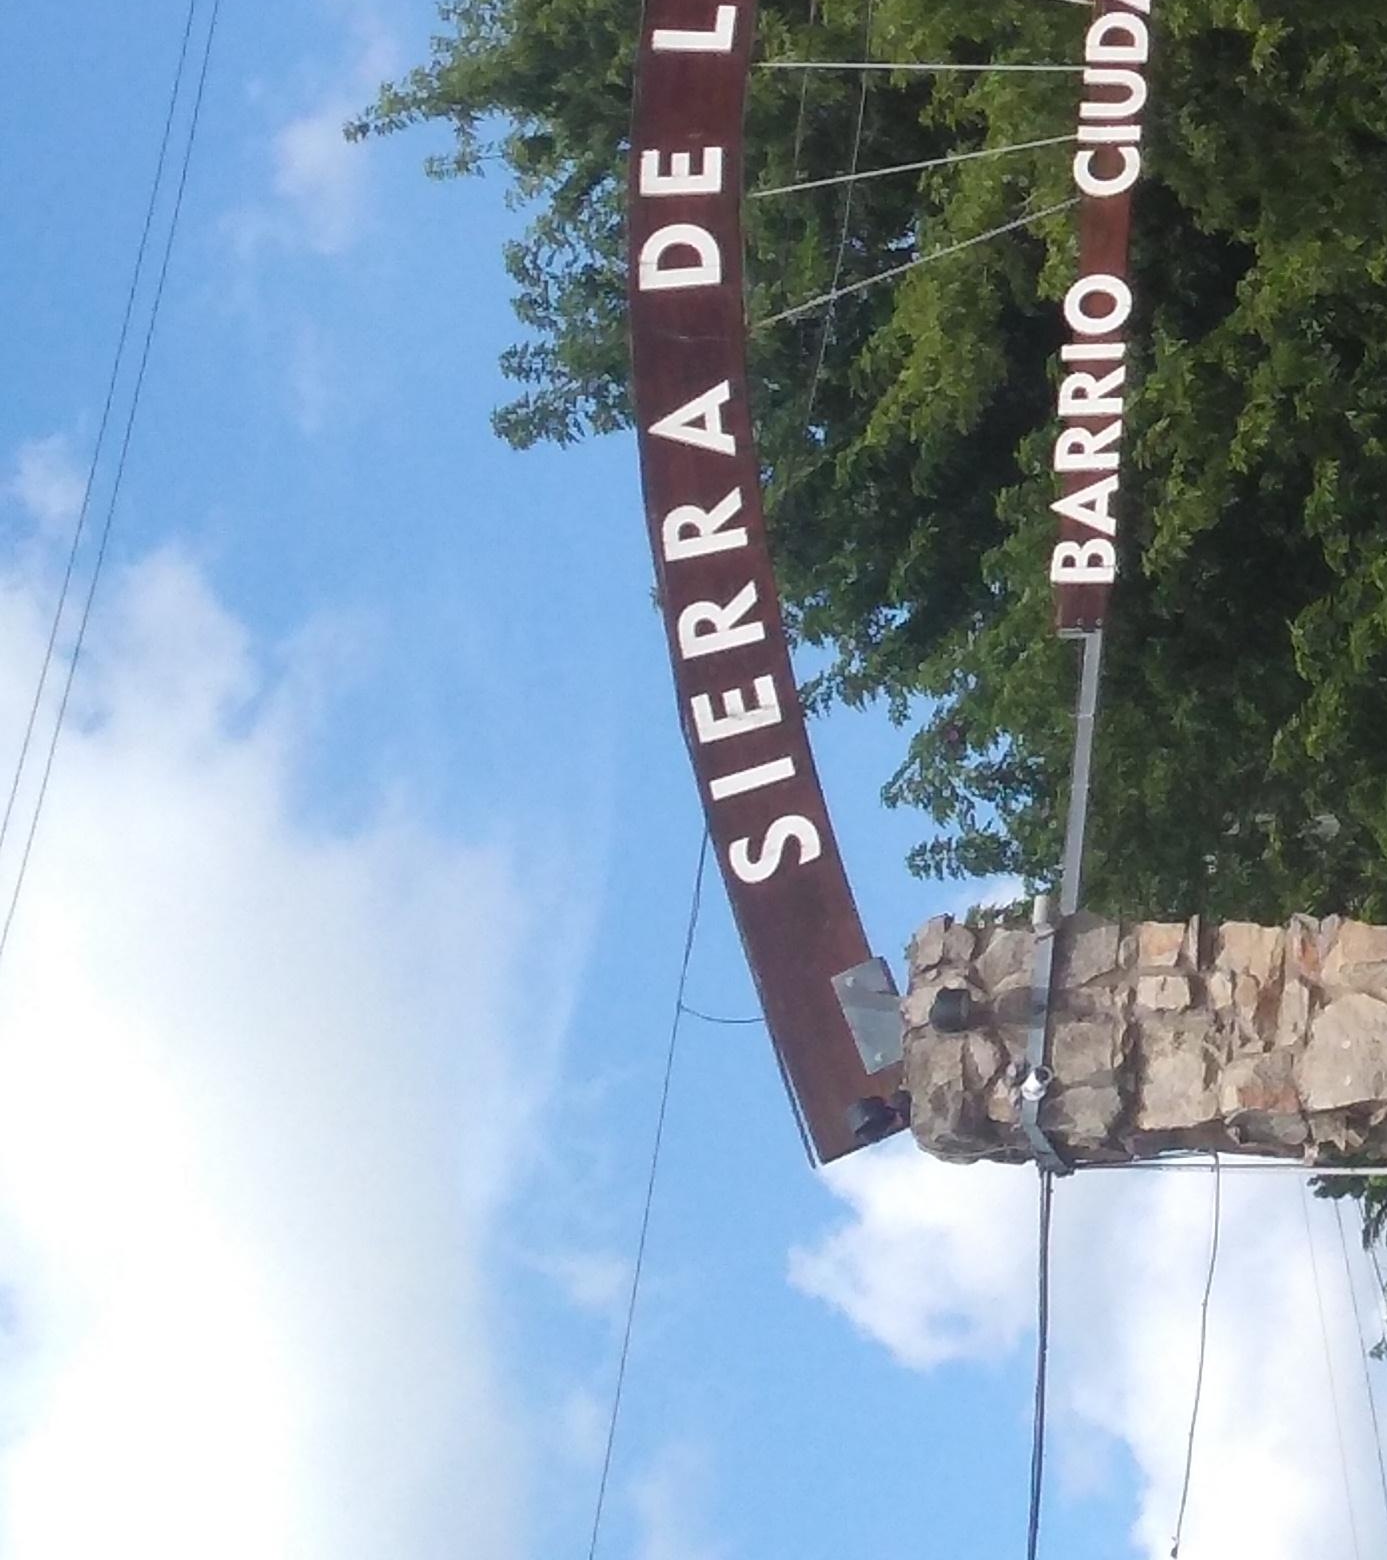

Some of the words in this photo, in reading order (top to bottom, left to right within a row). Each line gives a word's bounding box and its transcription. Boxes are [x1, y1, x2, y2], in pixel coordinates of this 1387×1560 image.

[638, 146, 723, 291] DE
[1049, 273, 1133, 584] BARRIO
[648, 379, 822, 883] SIERRA
